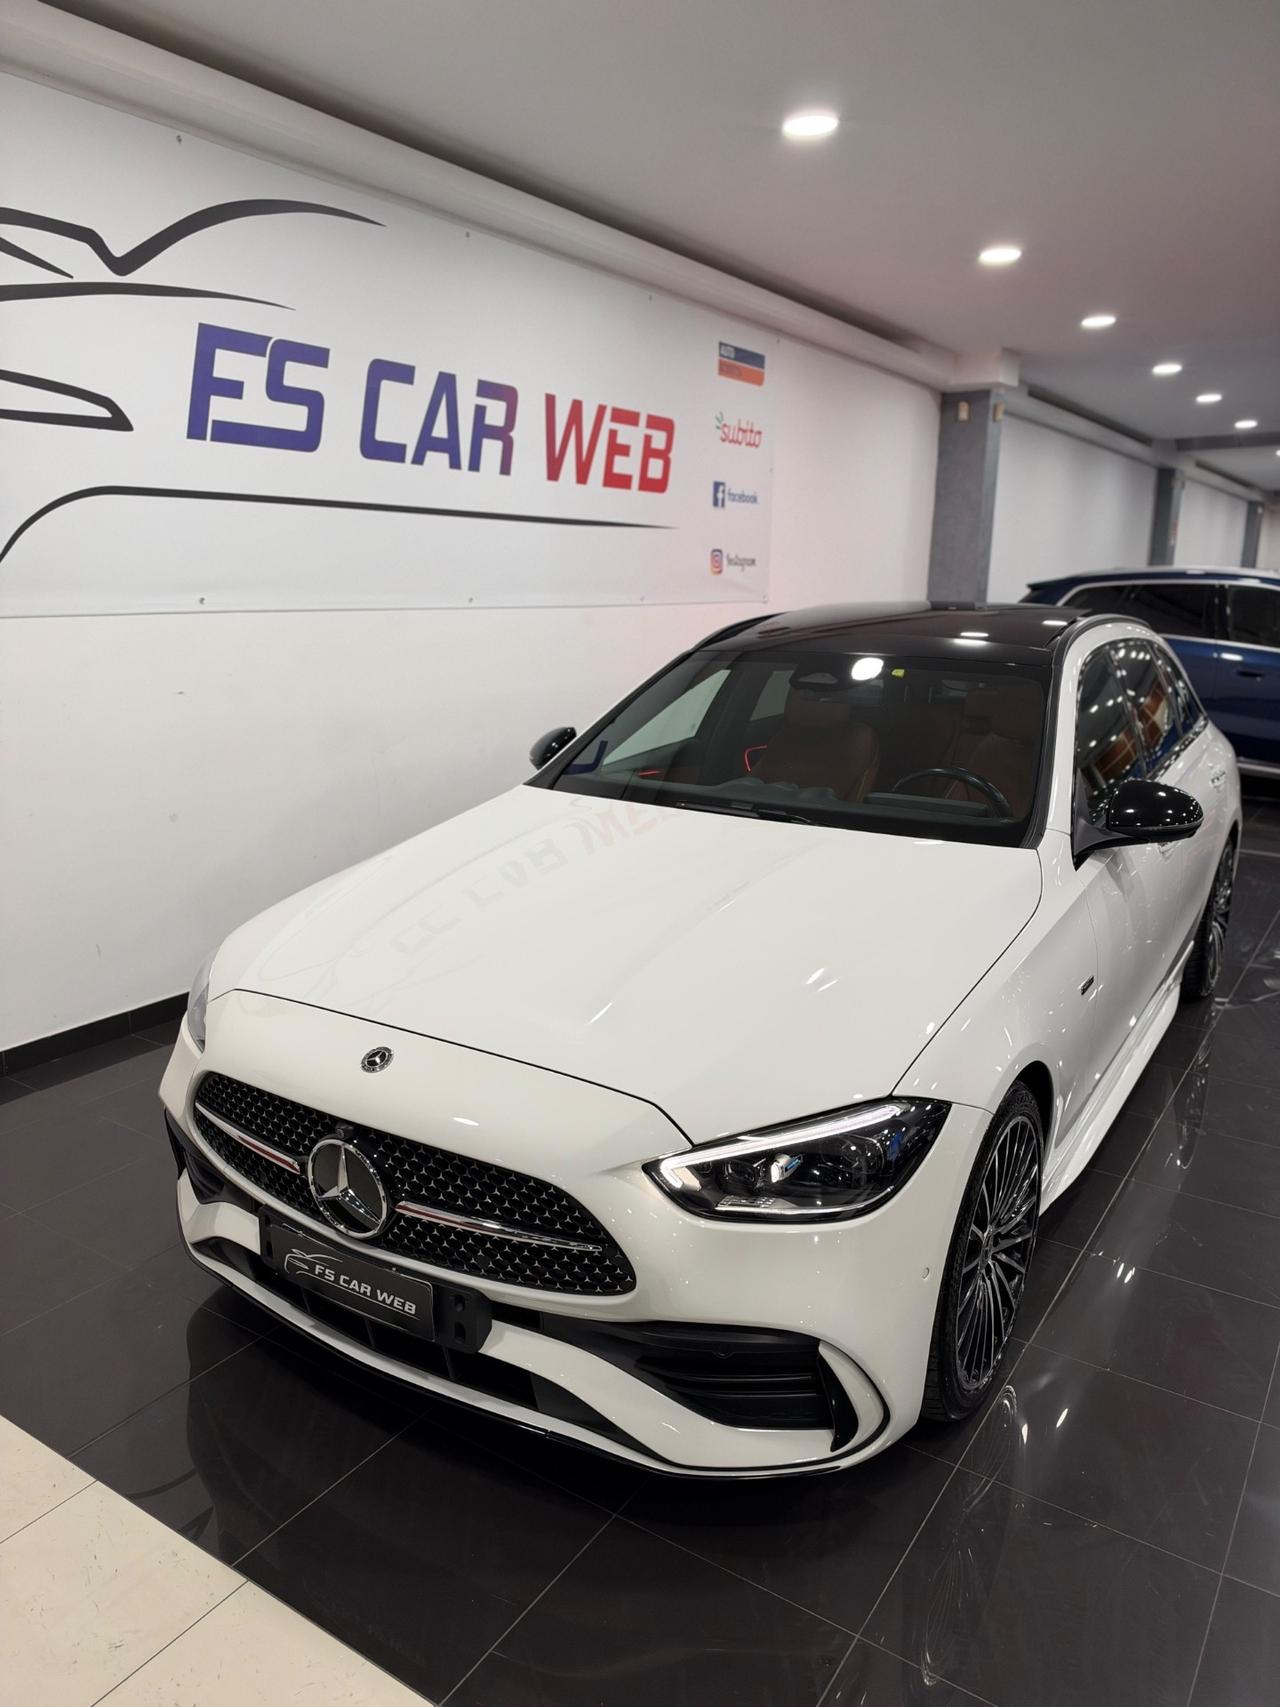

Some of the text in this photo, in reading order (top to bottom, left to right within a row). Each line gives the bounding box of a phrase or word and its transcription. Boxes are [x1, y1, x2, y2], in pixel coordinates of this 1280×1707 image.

[359, 358, 519, 477] CAR
[544, 392, 676, 494] WEB
[720, 419, 762, 448] subito
[727, 488, 758, 504] facebook
[314, 1264, 417, 1314] FS CAR WEB
